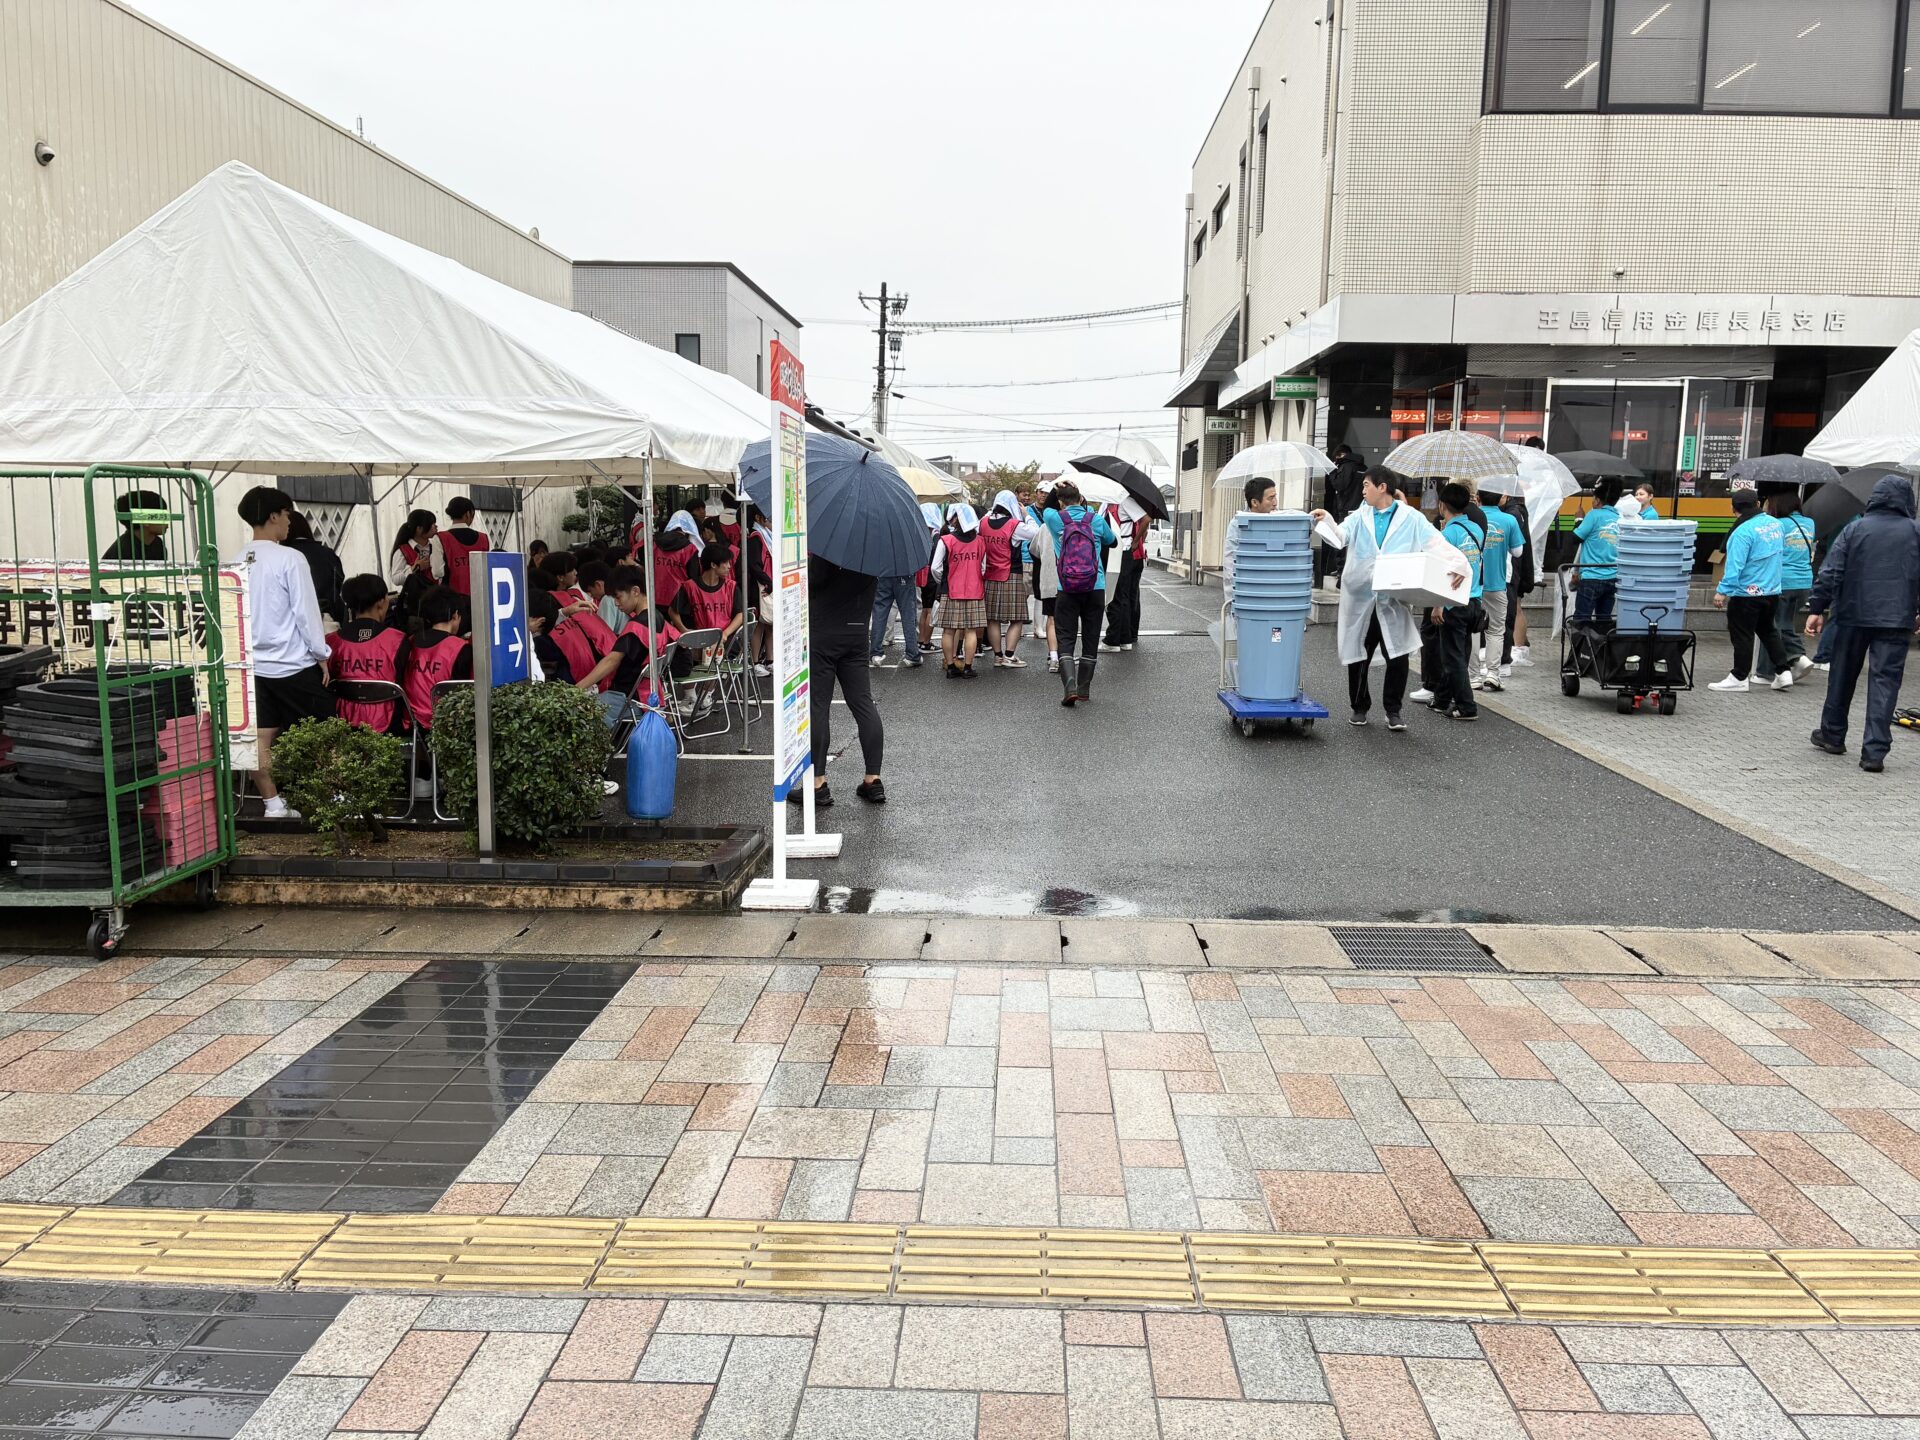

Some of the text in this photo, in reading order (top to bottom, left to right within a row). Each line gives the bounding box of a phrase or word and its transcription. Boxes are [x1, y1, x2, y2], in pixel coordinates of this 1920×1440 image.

[1538, 308, 1845, 332] 玉島信用金庫長尾支店
[1211, 421, 1239, 429] 夜間金庫
[1734, 481, 1751, 489] SOS
[492, 568, 515, 646] P
[691, 602, 726, 614] STAFF
